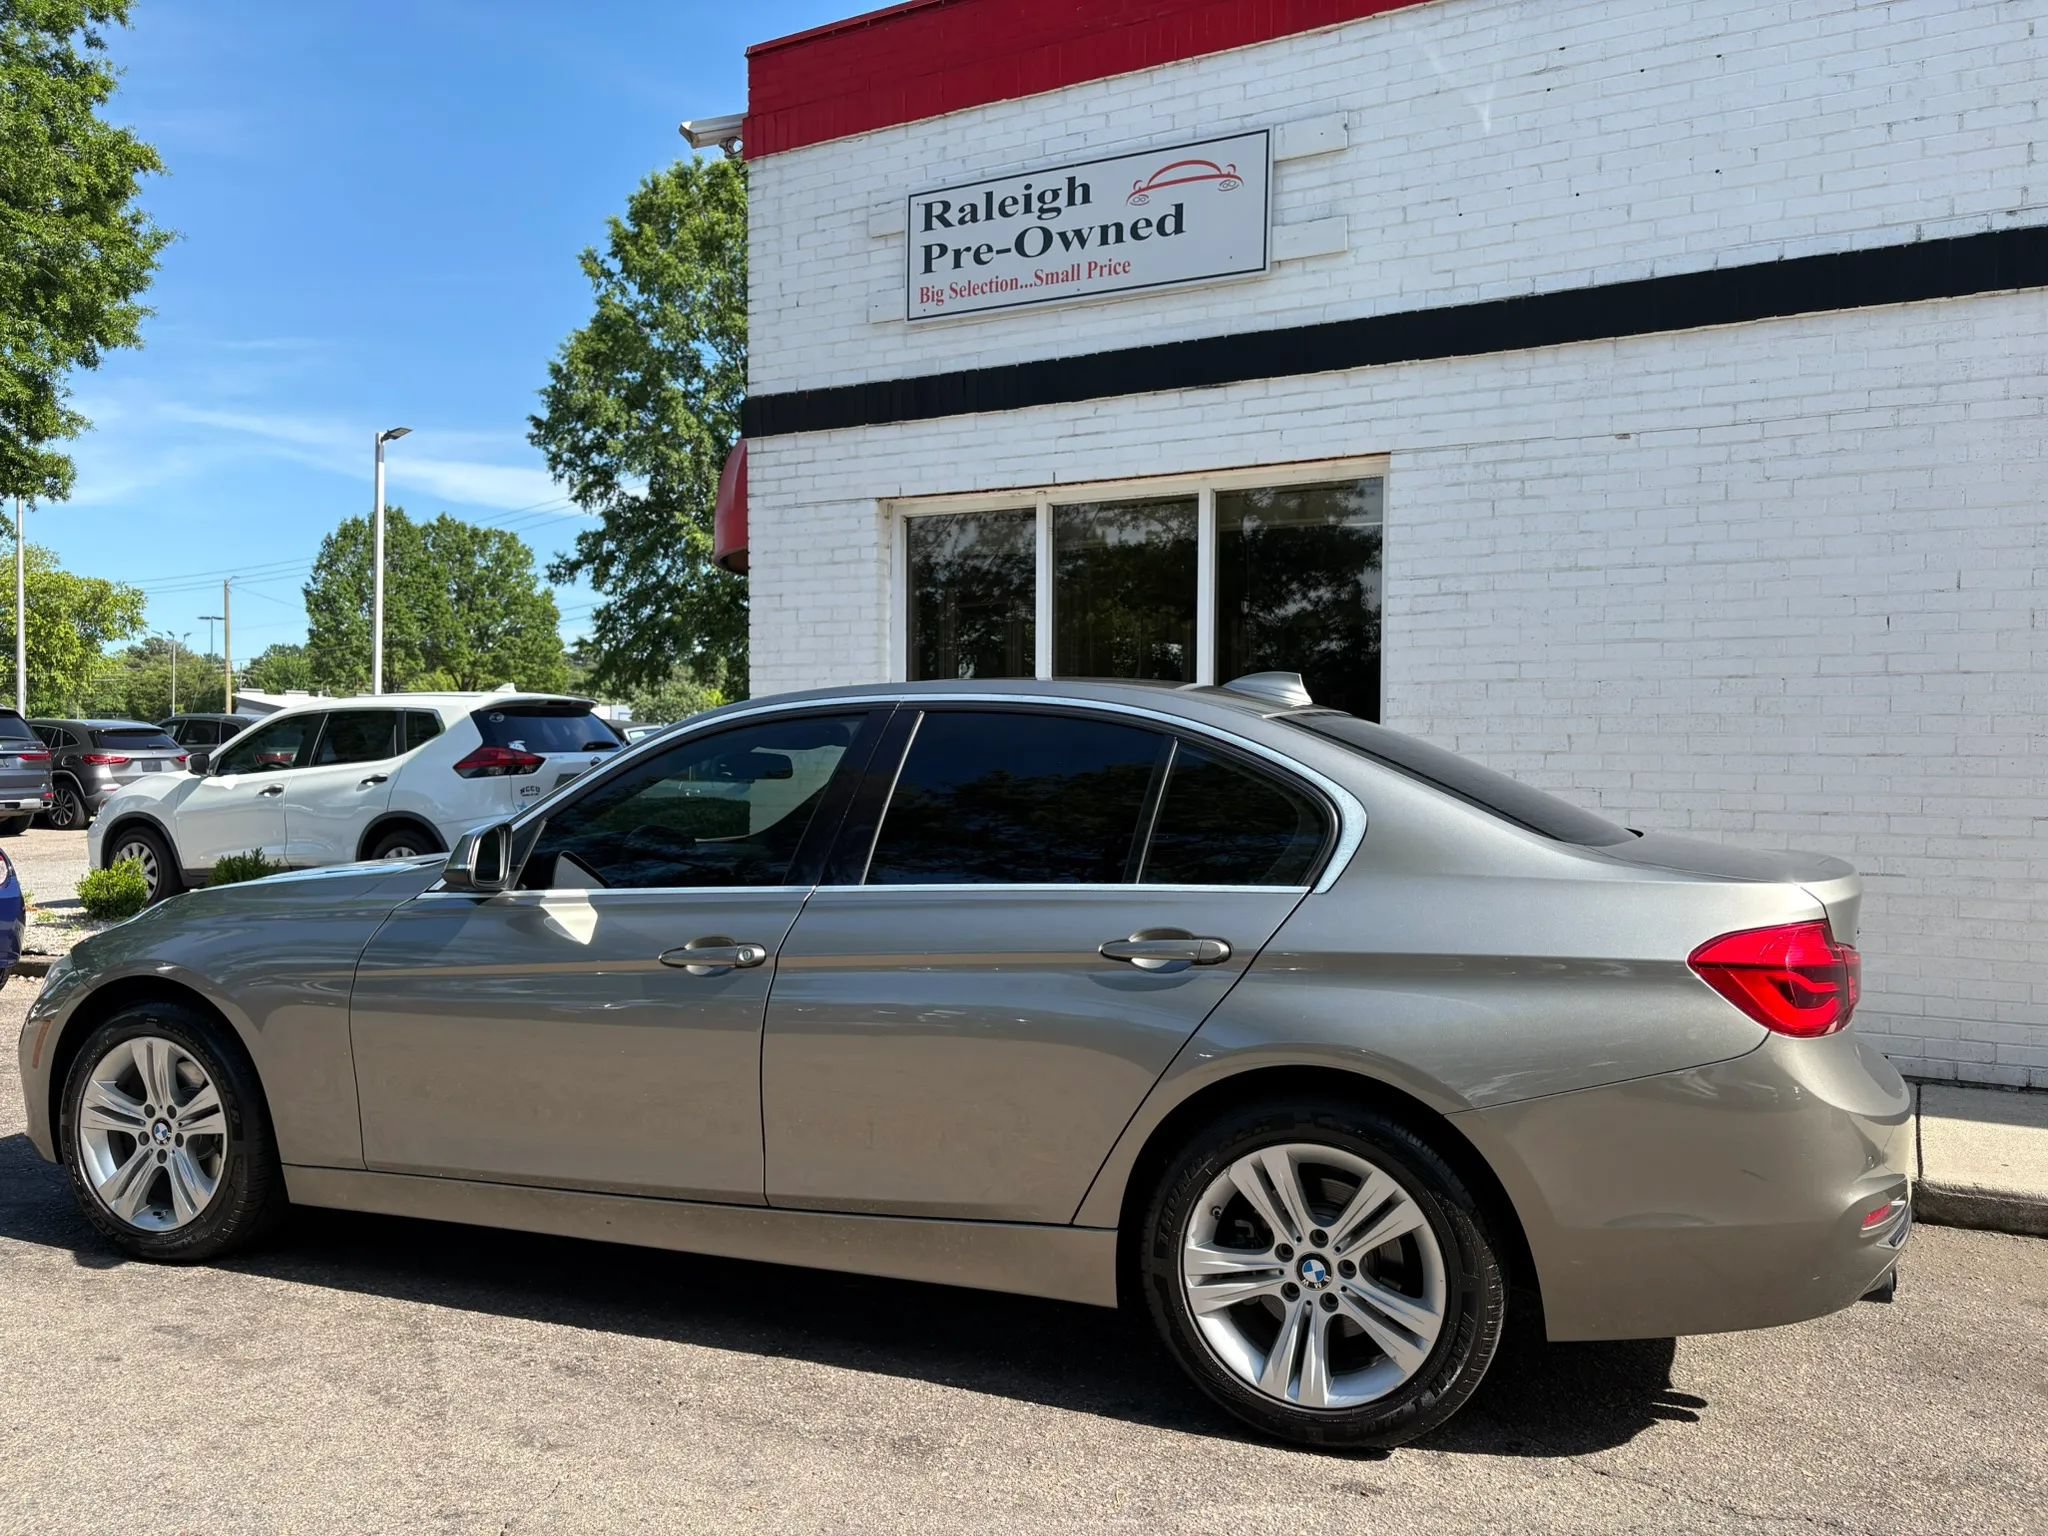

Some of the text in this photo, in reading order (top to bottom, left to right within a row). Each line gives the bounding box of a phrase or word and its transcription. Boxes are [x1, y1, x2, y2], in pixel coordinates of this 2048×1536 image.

[920, 176, 1092, 232] Raleigh
[920, 203, 1187, 274] Pre-Owned
[920, 258, 1131, 305] Big Selection...Small Price
